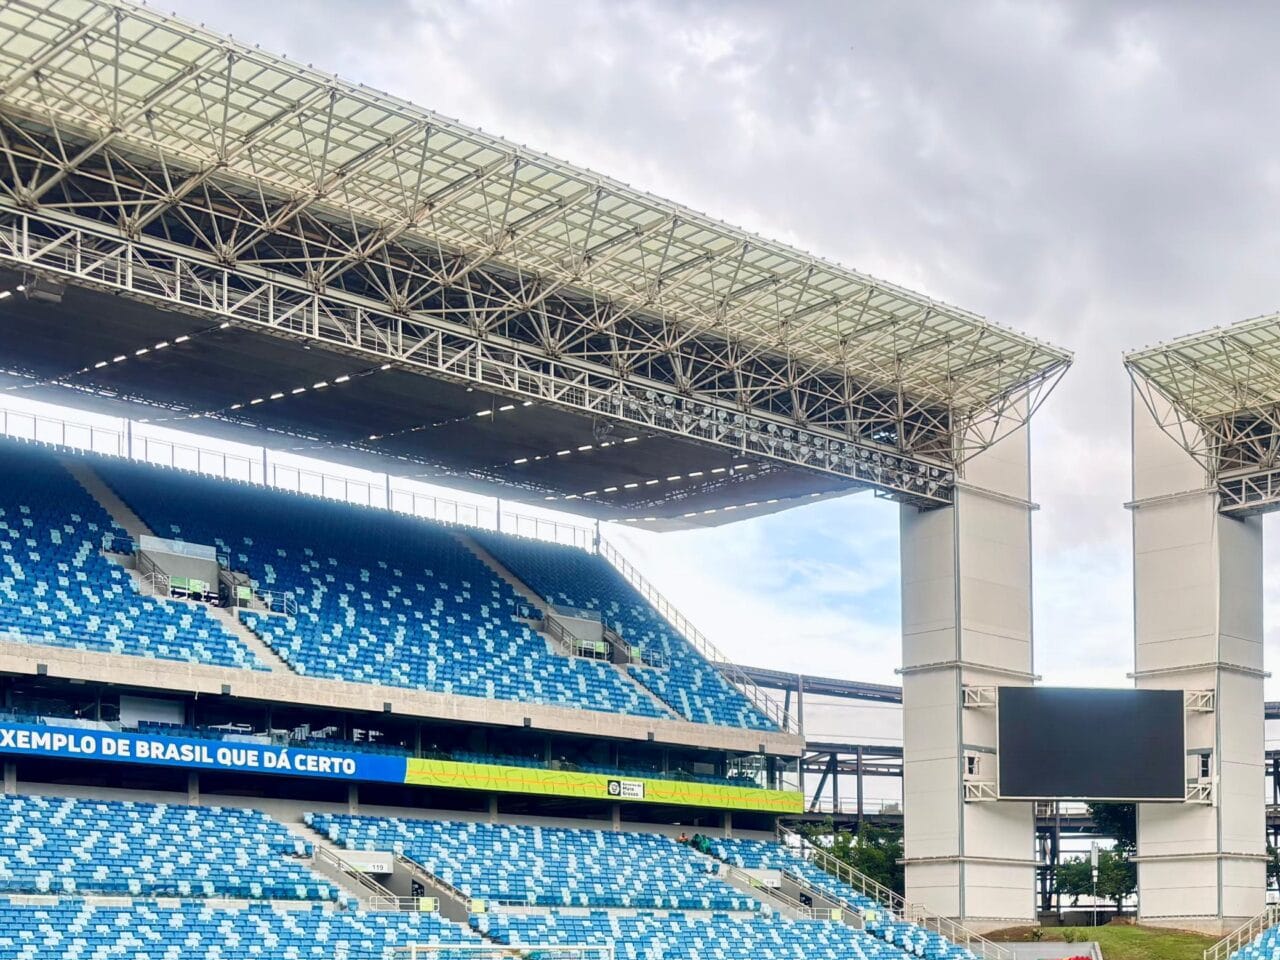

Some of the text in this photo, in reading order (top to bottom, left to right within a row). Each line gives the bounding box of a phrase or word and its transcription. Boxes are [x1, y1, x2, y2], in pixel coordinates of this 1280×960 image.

[0, 728, 356, 775] XEMPLO DE BRASIL QUE DÁ CERTO
